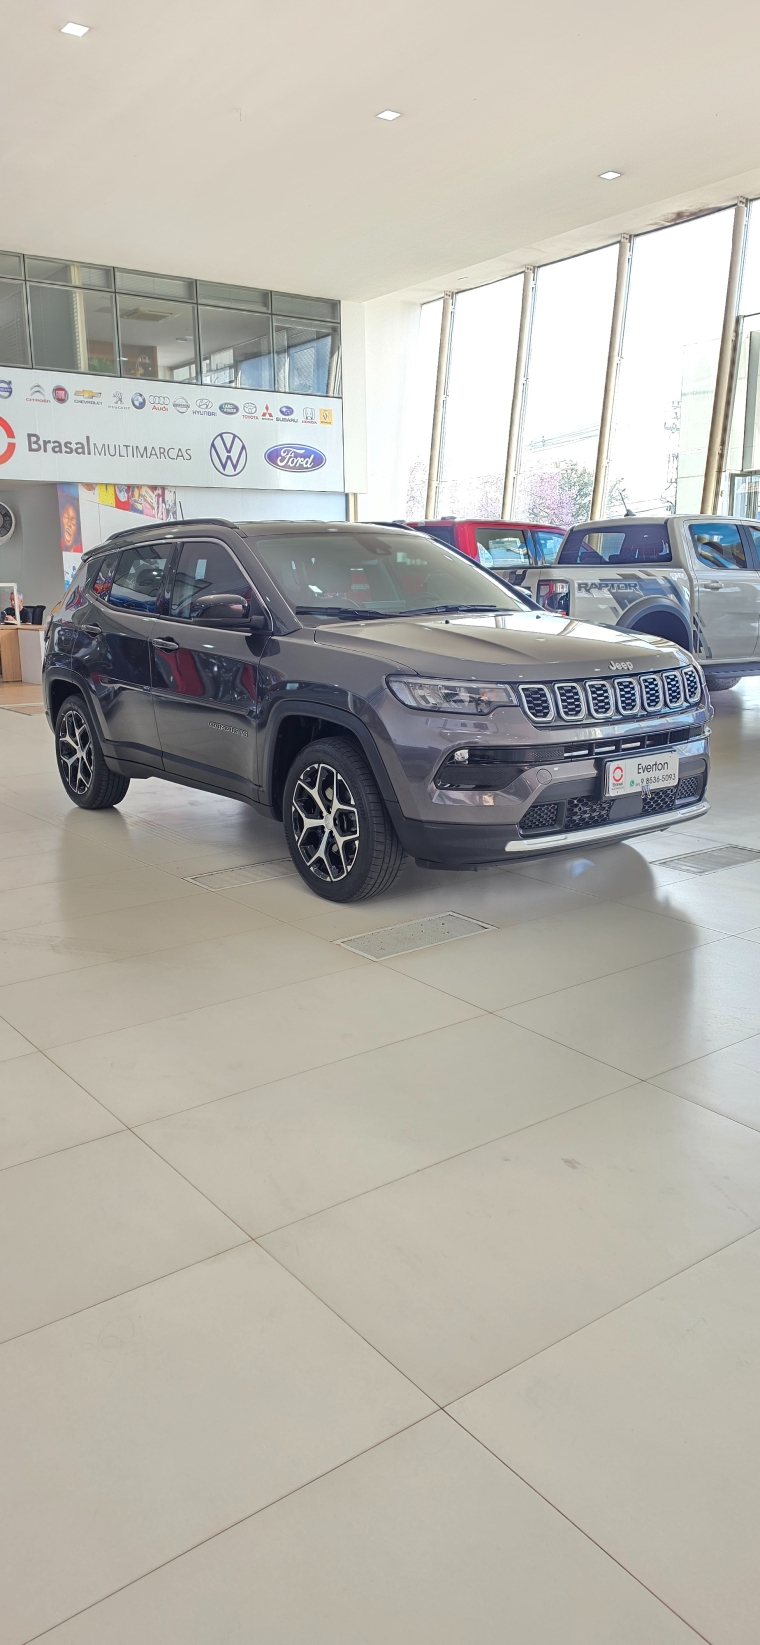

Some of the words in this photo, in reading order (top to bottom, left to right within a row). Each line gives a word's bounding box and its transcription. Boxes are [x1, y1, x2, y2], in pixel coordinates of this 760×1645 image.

[277, 447, 314, 469] Ford
[577, 581, 643, 595] RAPTOR
[607, 660, 634, 671] Jeep
[637, 760, 669, 775] Everton
[646, 773, 676, 785] 8536-5093
